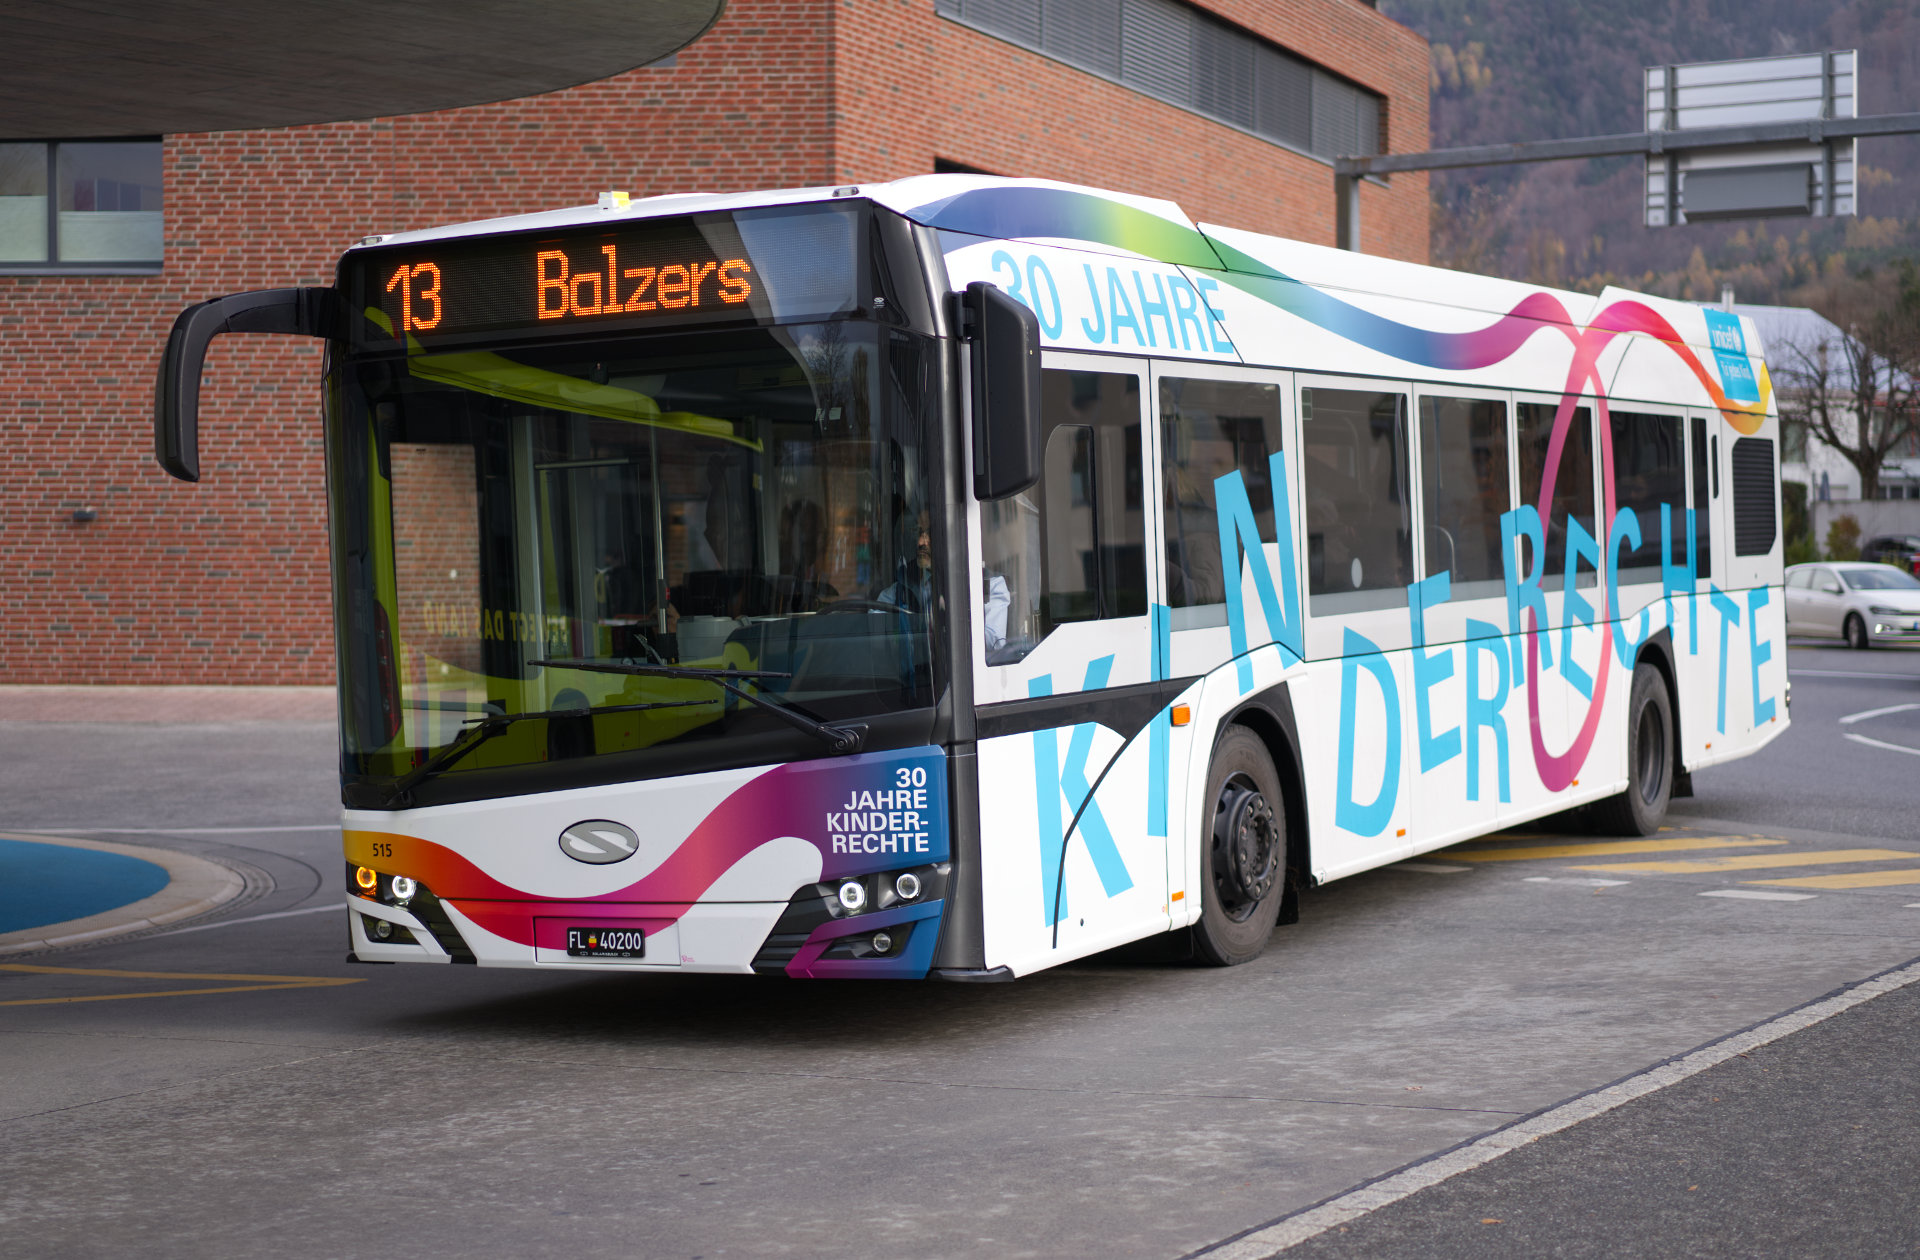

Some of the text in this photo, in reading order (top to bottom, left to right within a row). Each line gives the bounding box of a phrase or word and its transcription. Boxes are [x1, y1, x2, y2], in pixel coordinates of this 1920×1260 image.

[387, 244, 751, 331] 13 Balzers
[991, 250, 1234, 354] 30 JAHRE
[896, 766, 927, 788] 30
[844, 789, 928, 810] JAHRE
[826, 811, 929, 832] KINDER-
[372, 843, 392, 857] 515
[832, 832, 929, 853] RECHTE
[569, 931, 641, 950] FL 40200
